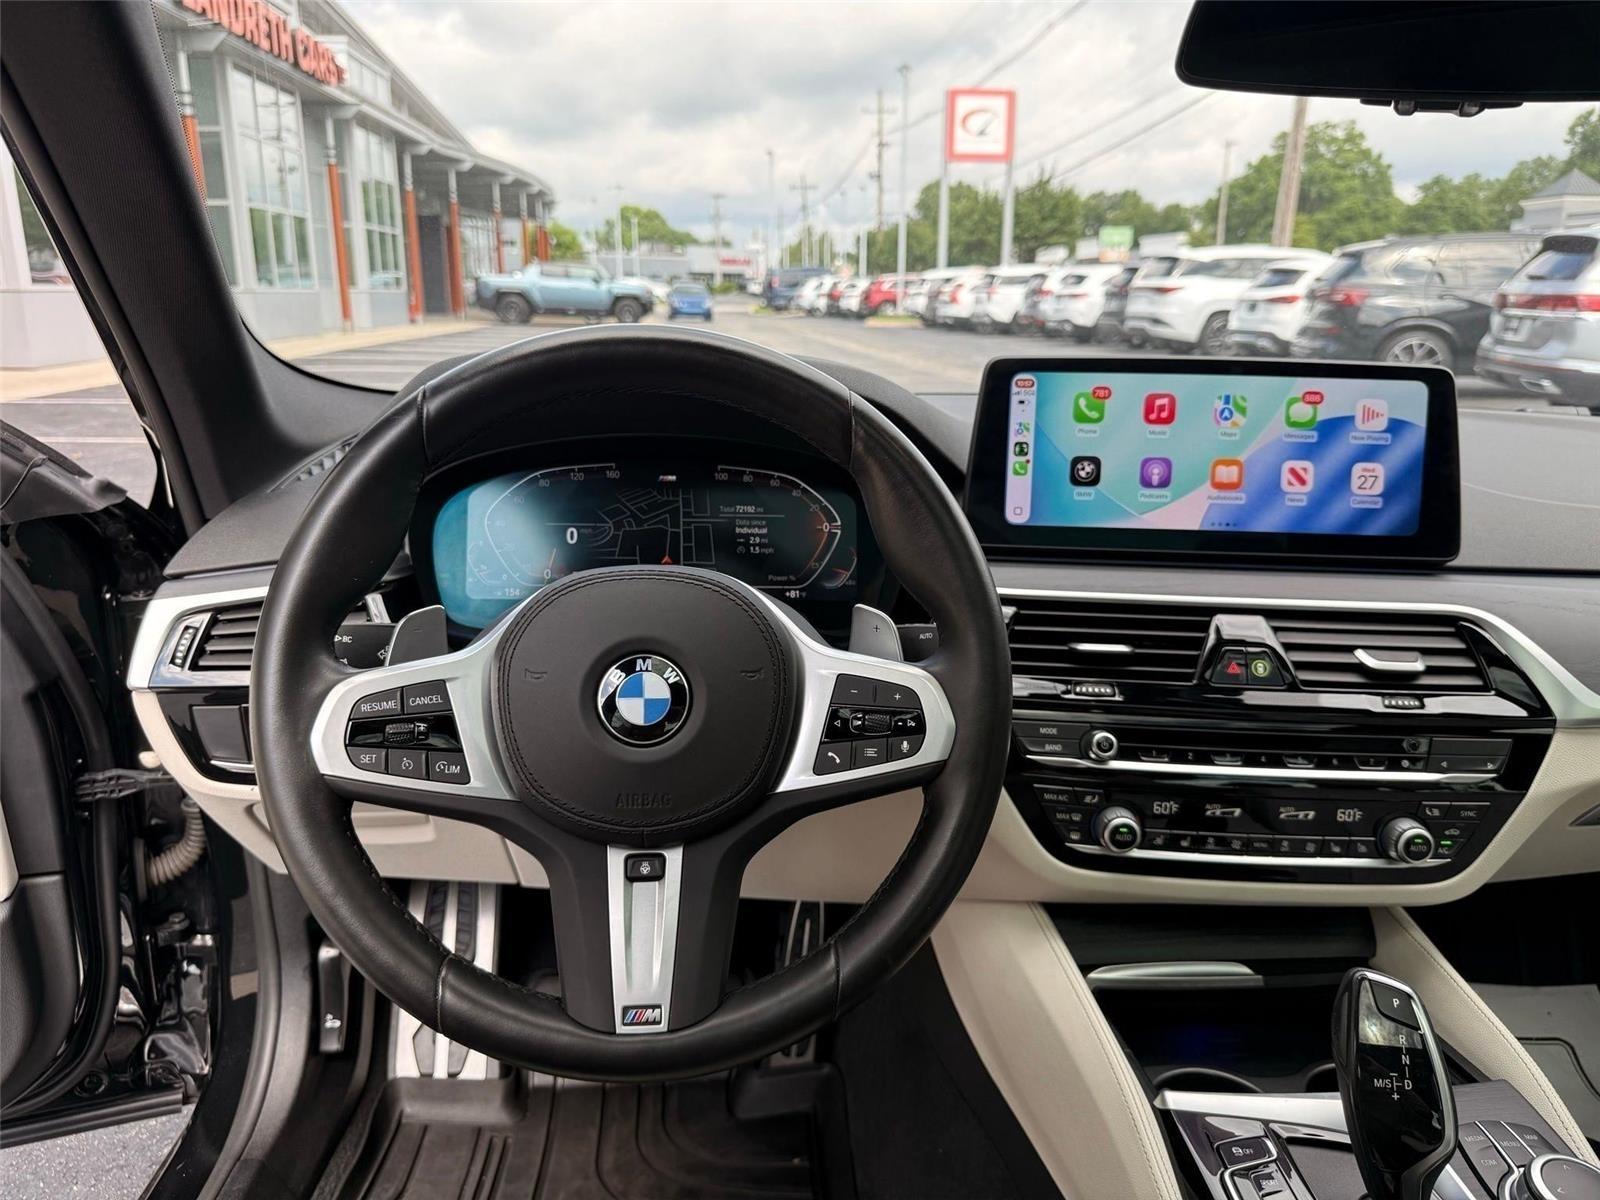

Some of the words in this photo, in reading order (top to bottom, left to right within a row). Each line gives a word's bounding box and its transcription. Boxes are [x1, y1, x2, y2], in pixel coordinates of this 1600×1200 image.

[570, 472, 584, 481] 120
[606, 470, 620, 479] 160
[715, 473, 728, 481] 100
[743, 475, 753, 483] 80
[770, 479, 780, 487] 60
[1357, 475, 1378, 490] 27
[566, 527, 579, 544] 0
[342, 635, 353, 643] BC
[919, 632, 933, 640] AUTO
[610, 658, 681, 684] BMW
[409, 695, 443, 706] CANCEL
[361, 700, 397, 712] RESUME
[1039, 727, 1058, 736] MODE
[1044, 743, 1063, 752] BAND
[360, 754, 377, 764] SET
[445, 765, 460, 774] LIM
[616, 793, 673, 809] AIRBAG
[1460, 809, 1477, 818] SYNC
[1115, 832, 1132, 841] AUTO
[1409, 844, 1427, 852] AUTO
[1392, 998, 1400, 1008] P
[1399, 1034, 1407, 1045] R
[1401, 1054, 1410, 1065] N
[1374, 1078, 1392, 1088] M/S
[1404, 1079, 1413, 1090] D
